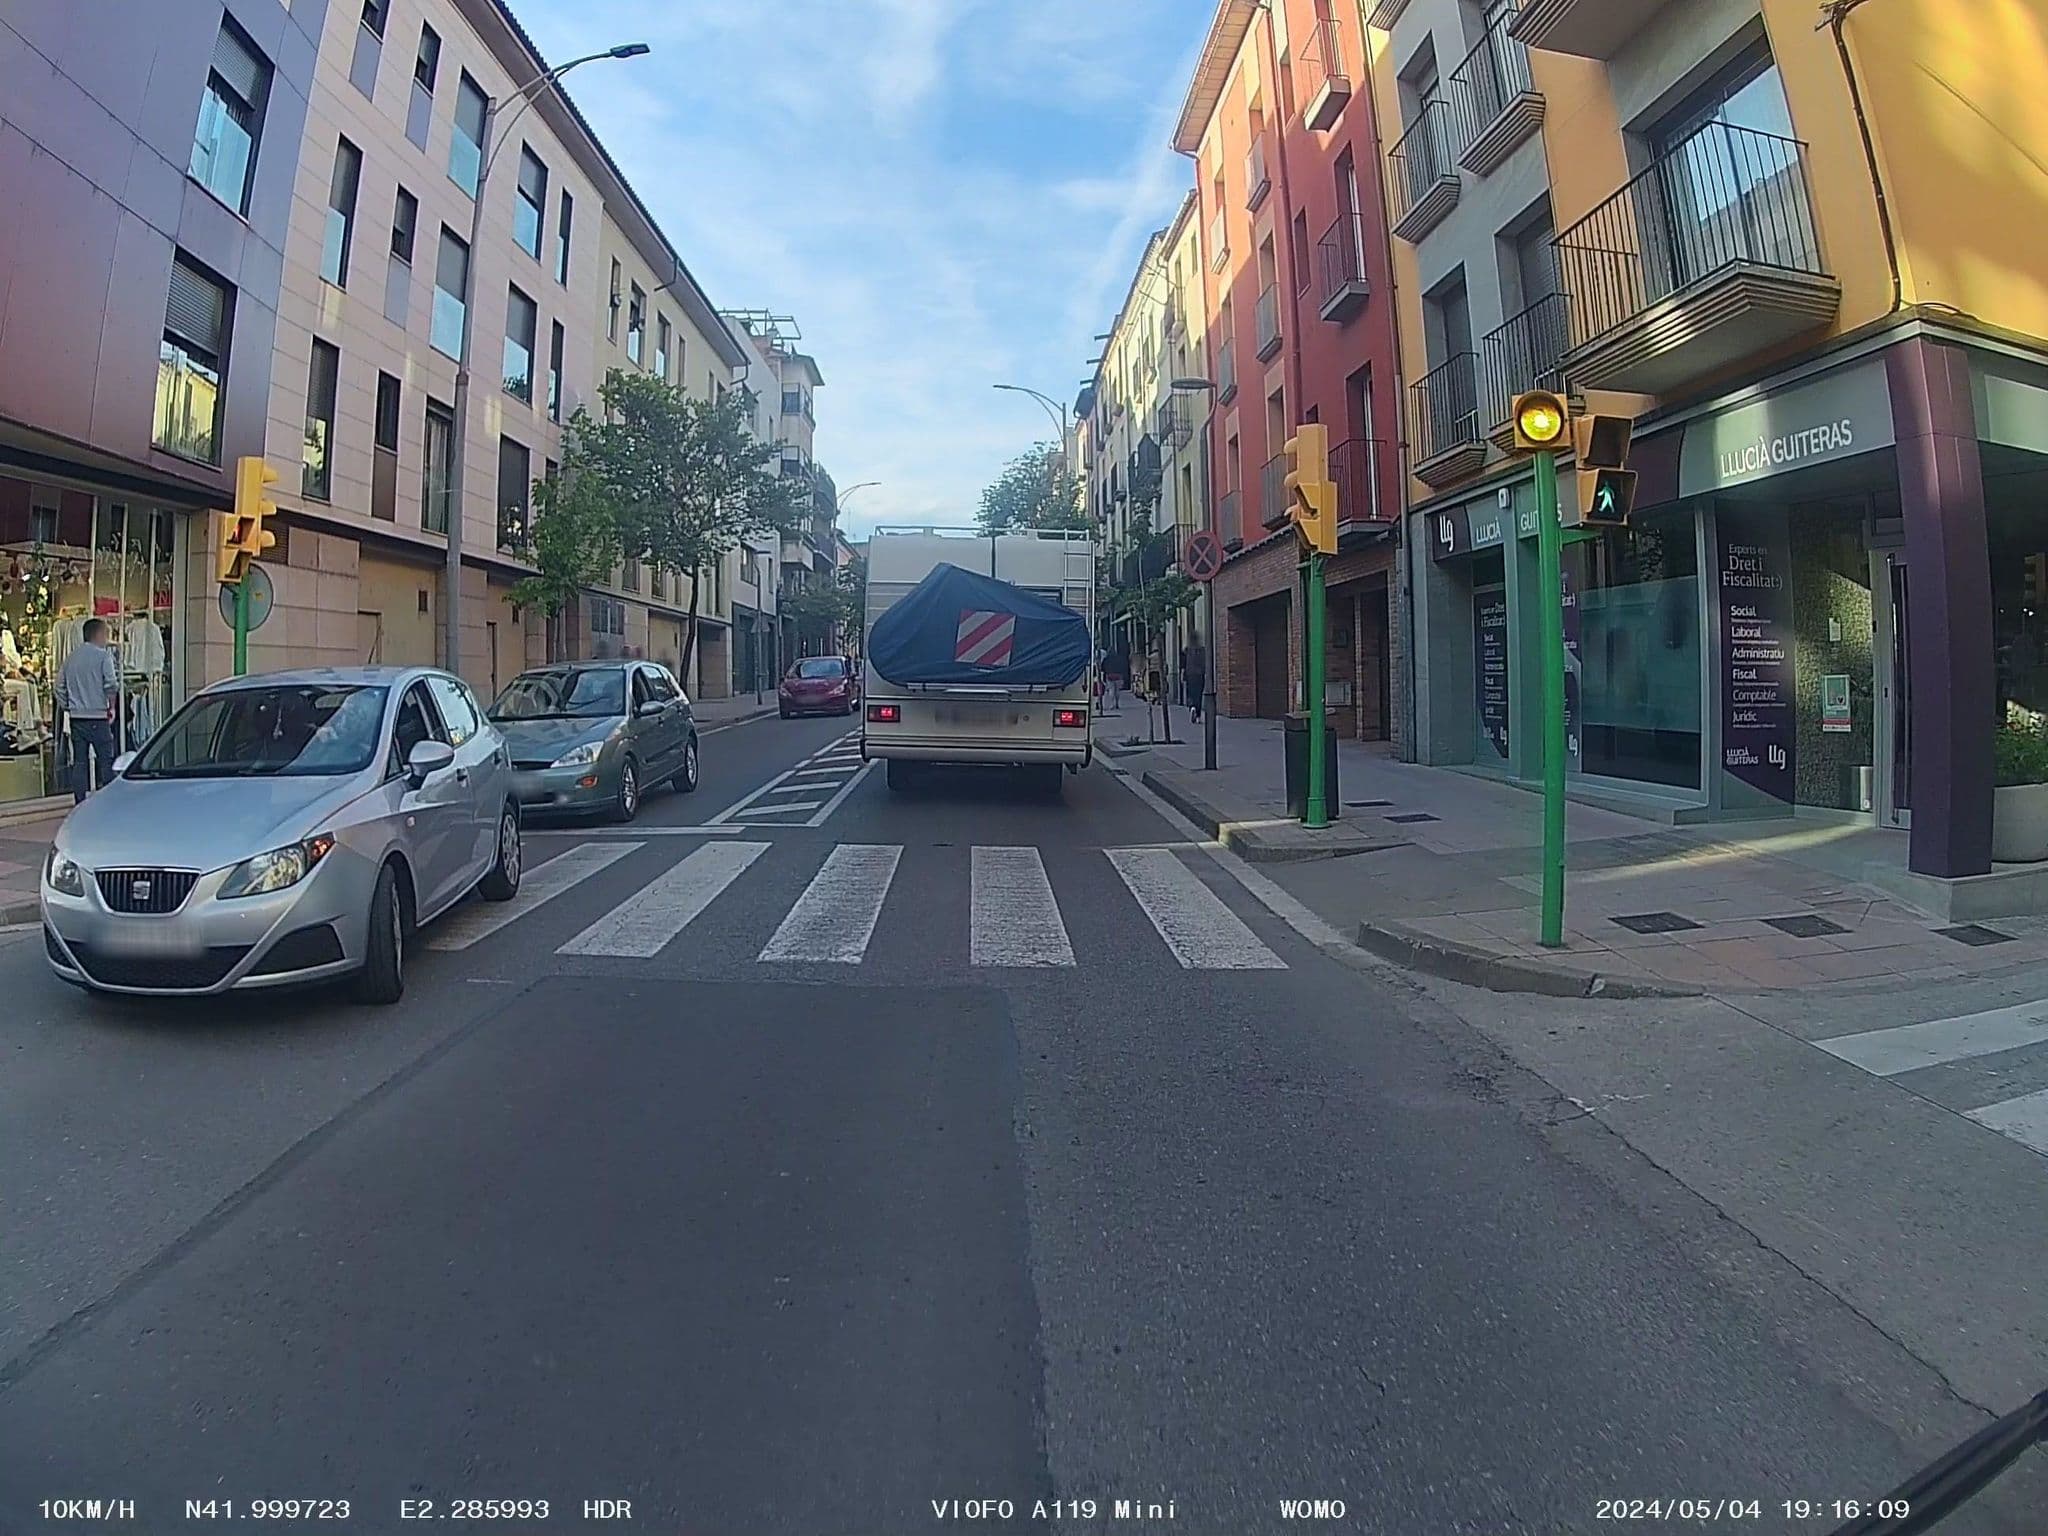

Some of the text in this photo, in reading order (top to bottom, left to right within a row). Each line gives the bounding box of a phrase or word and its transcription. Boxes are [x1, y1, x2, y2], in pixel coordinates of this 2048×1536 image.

[1720, 419, 1852, 478] LLUCIÀ GUITERAS
[1729, 555, 1757, 571] Dret
[1730, 605, 1757, 617] Social
[1731, 626, 1762, 638] Laboral
[1732, 647, 1785, 659] Administratiu
[1732, 668, 1757, 680] Fiscal
[1732, 689, 1777, 703] Comptable
